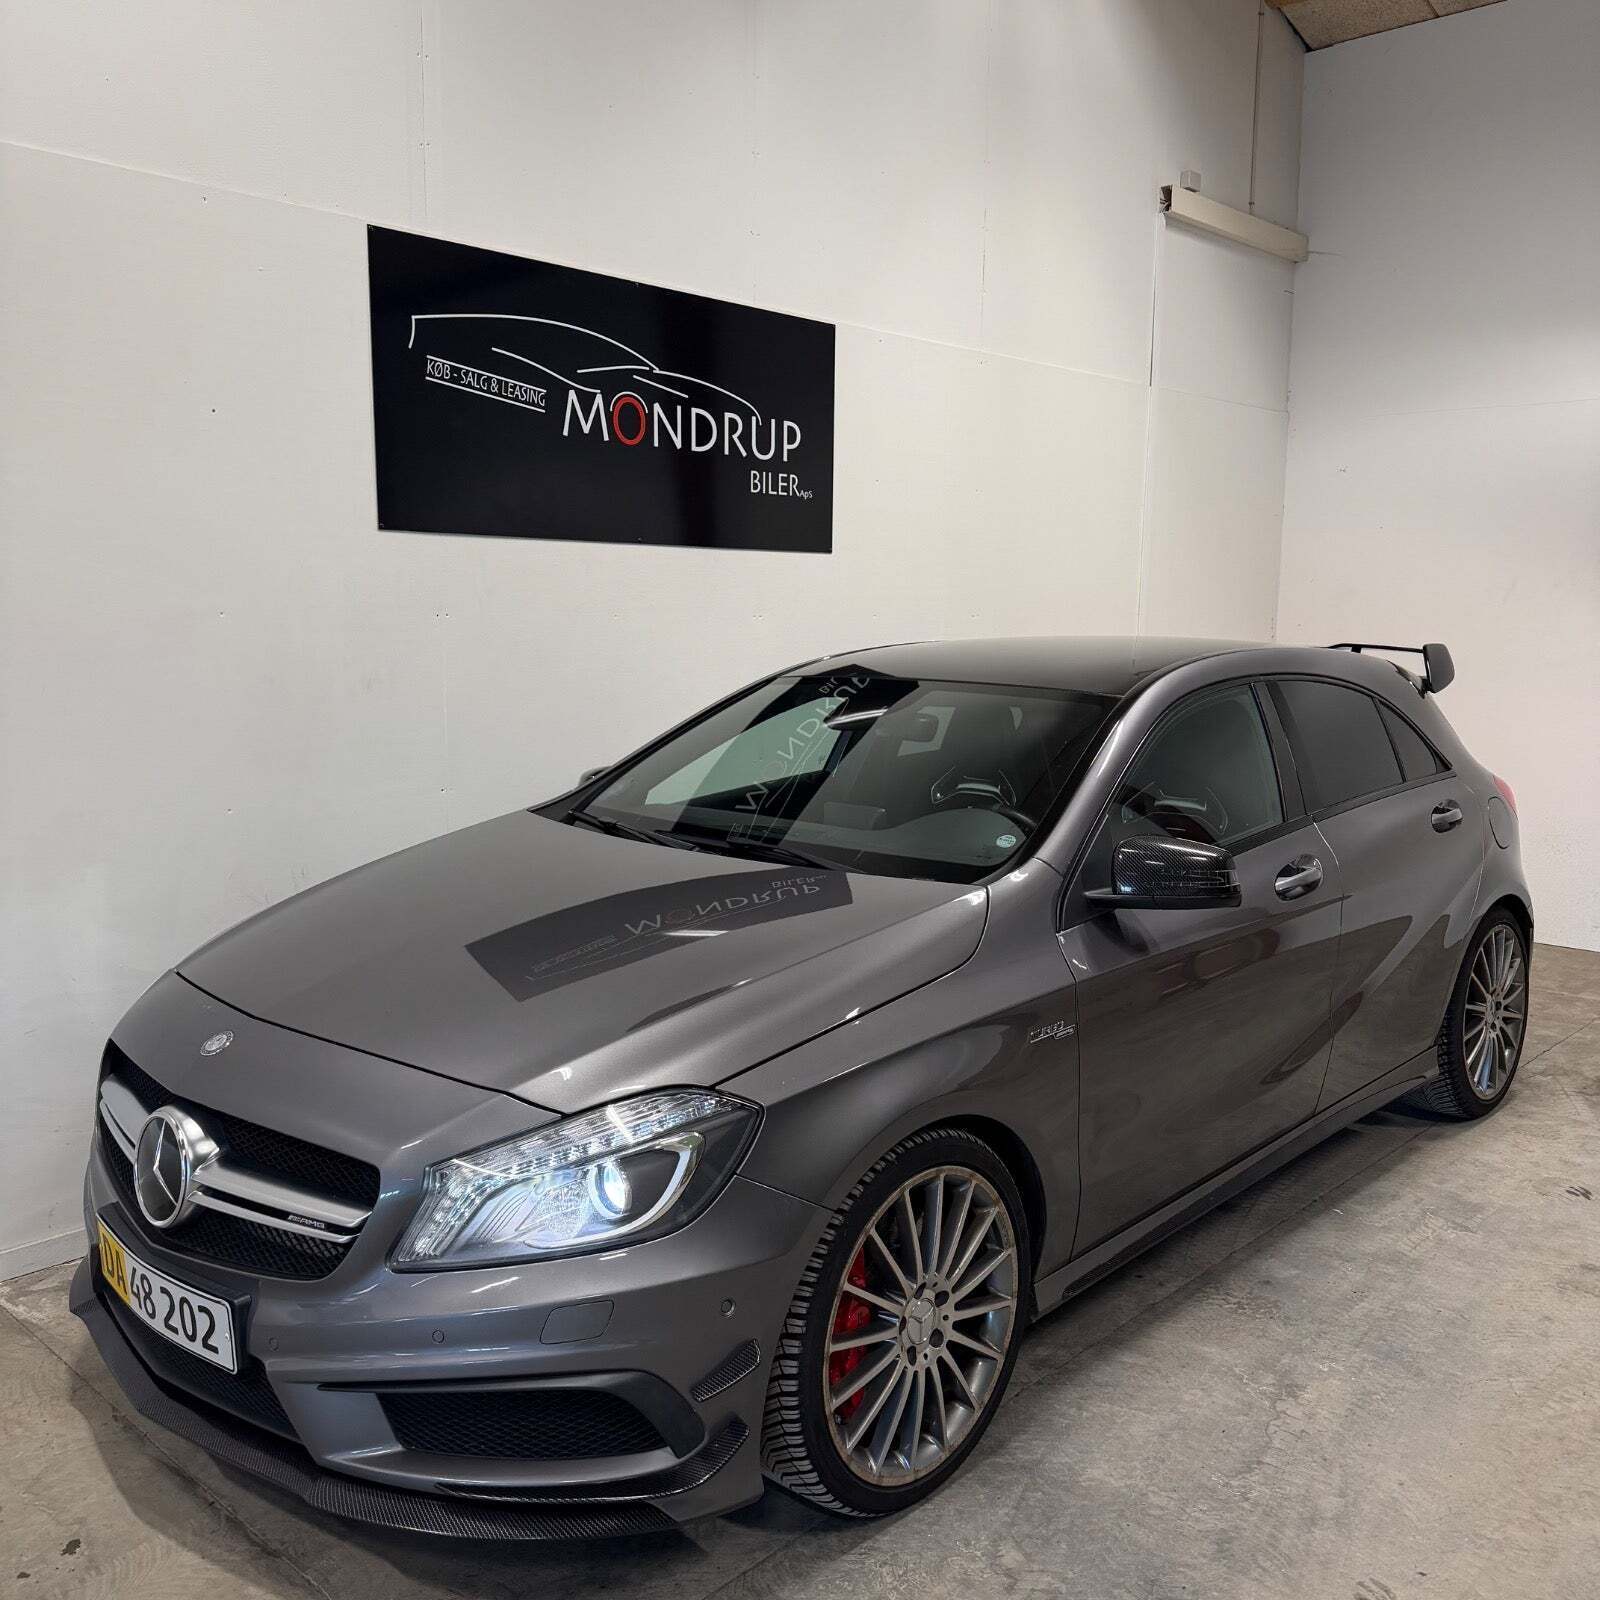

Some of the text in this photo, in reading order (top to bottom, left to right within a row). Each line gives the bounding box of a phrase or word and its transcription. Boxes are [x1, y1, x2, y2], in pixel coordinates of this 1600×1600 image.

[426, 360, 451, 379] KØB
[460, 369, 488, 390] SALG
[490, 378, 499, 393] &
[501, 381, 546, 407] LEASING
[563, 389, 801, 462] MONDRUP
[750, 470, 800, 497] BILER
[101, 1232, 219, 1355] DA 48 202
